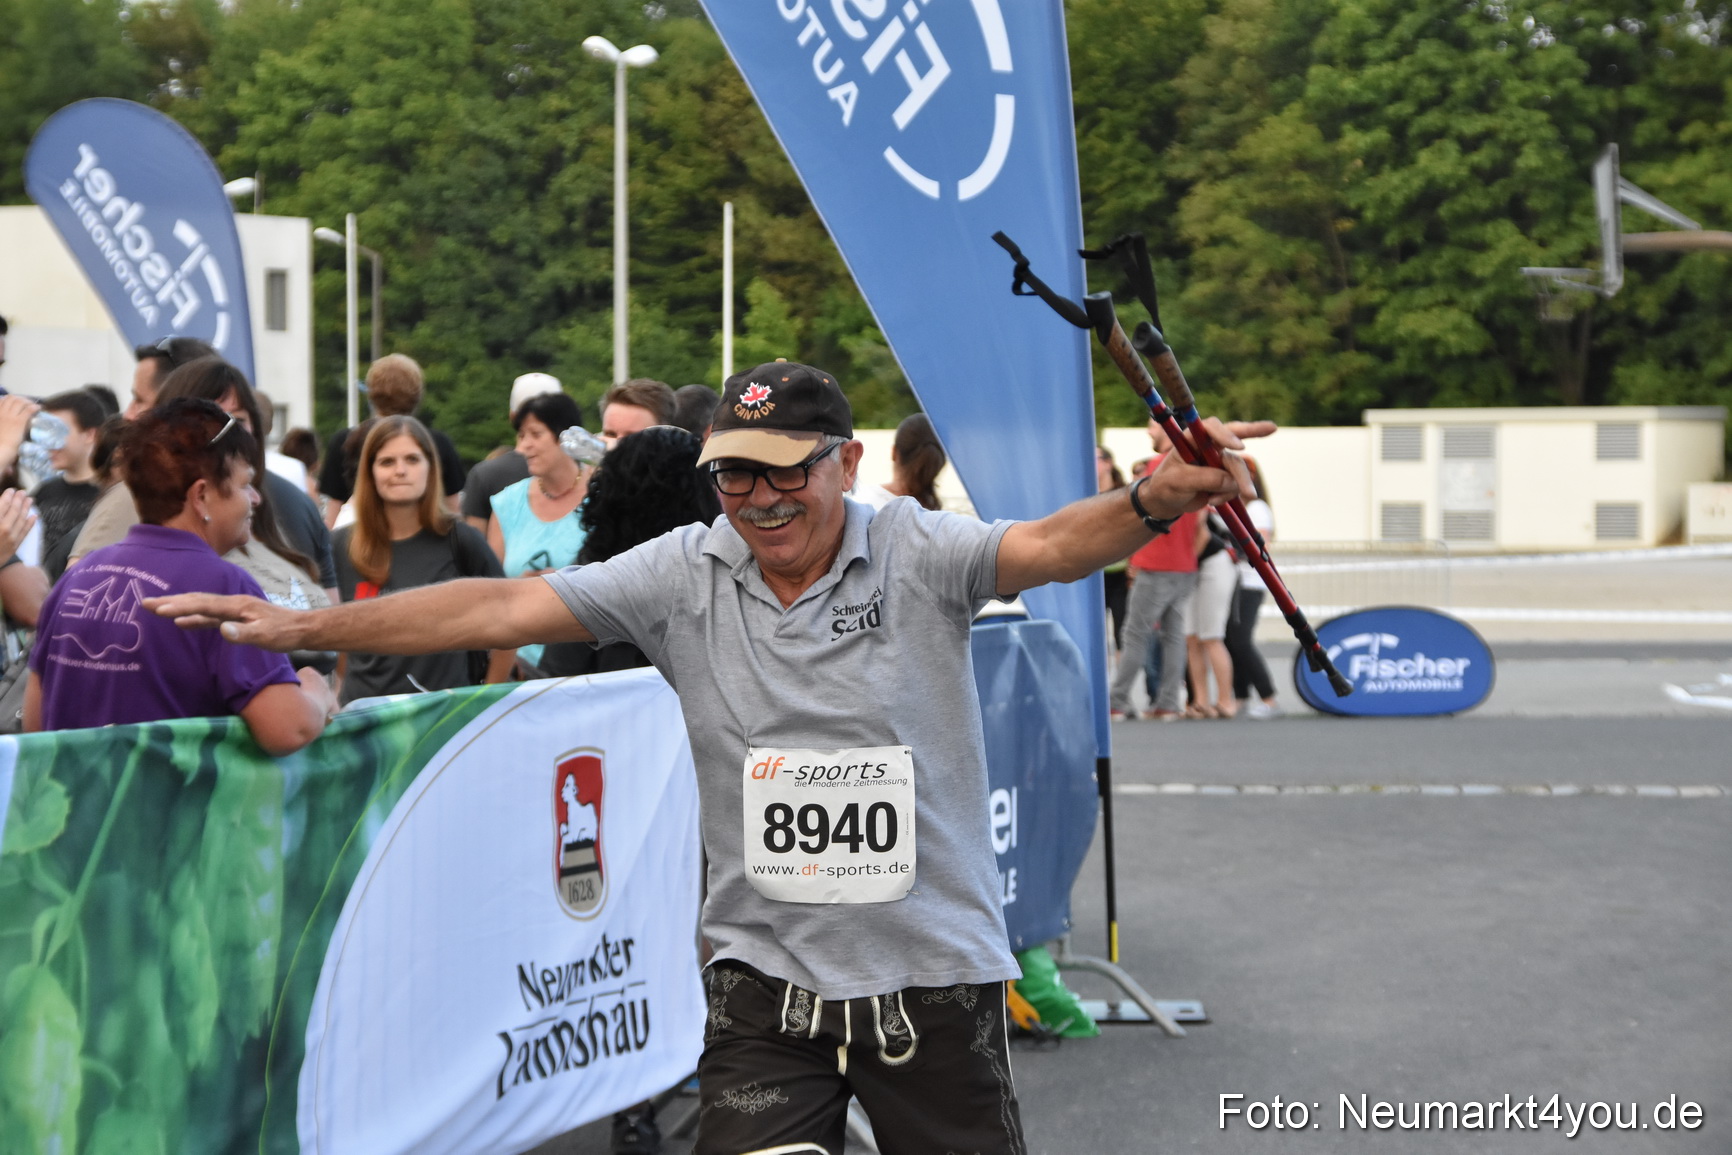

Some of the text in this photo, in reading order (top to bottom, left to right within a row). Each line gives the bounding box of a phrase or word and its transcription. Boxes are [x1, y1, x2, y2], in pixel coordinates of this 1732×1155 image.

[733, 401, 776, 420] CANADA
[124, 566, 170, 591] Kinderhaus
[1348, 652, 1471, 681] Fischer
[1363, 678, 1463, 693] AUTOMOBILE
[751, 756, 887, 785] df-sports
[794, 778, 908, 788] die moderne Zeitmessung
[763, 801, 897, 854] 8940
[752, 862, 910, 878] www.df-sports.de
[567, 878, 595, 905] 1628
